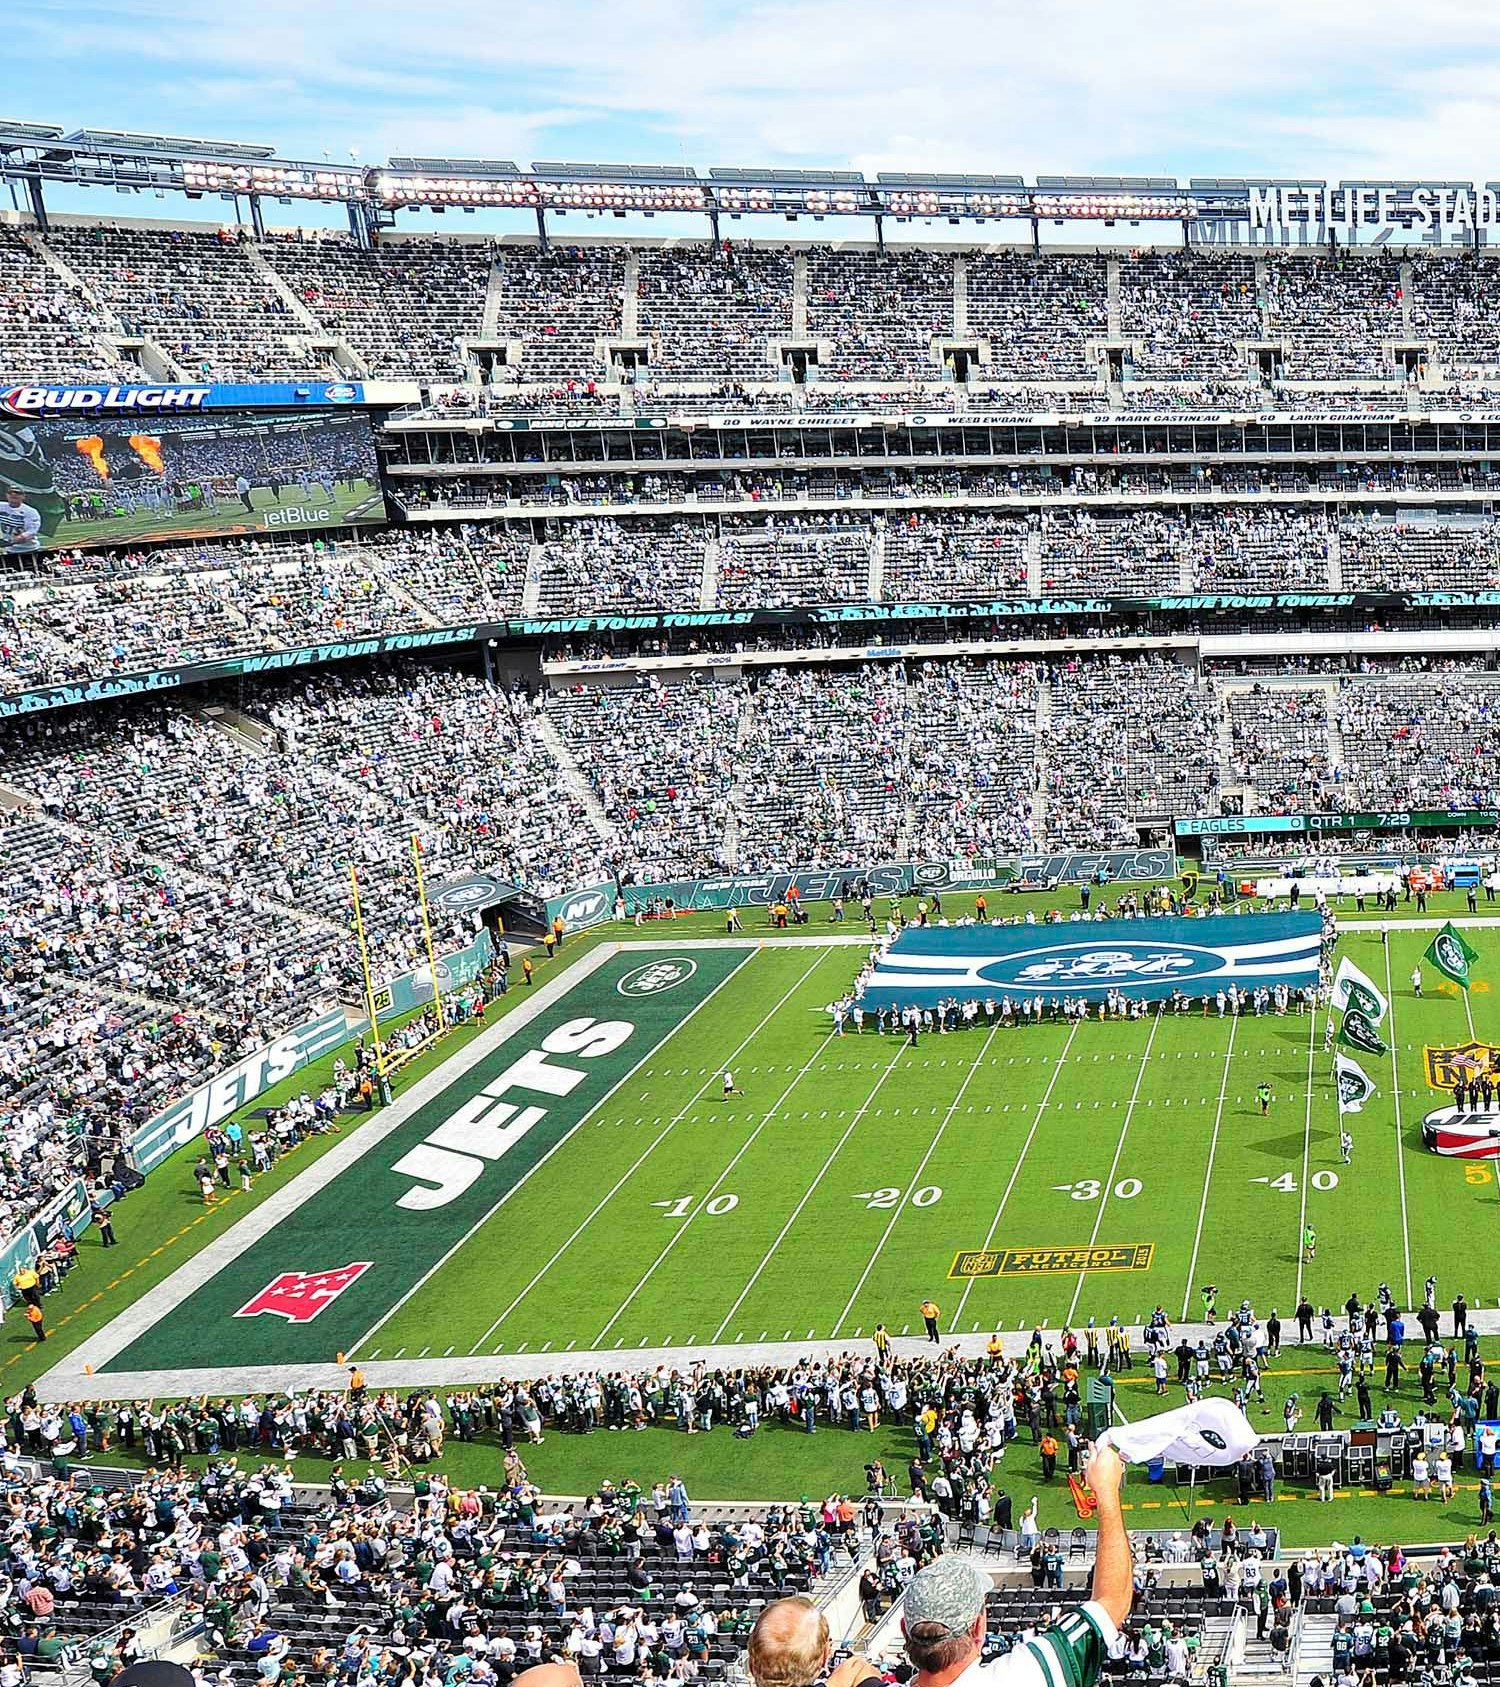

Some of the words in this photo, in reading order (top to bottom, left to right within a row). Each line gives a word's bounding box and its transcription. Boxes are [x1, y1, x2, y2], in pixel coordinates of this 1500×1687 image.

[1249, 186, 1400, 229] METLIFE
[15, 387, 102, 410] BUD
[103, 387, 211, 409] LIGHT
[750, 418, 795, 427] WAYNE
[797, 417, 858, 426] CHREBET
[983, 416, 1034, 425] EWBANK
[1115, 415, 1150, 424] MARK
[1290, 413, 1328, 422] LARRY
[1329, 413, 1396, 422] GRANTHAM
[262, 507, 331, 529] jetBlue
[1160, 595, 1216, 611] WAVE
[1215, 595, 1274, 609] YOUR
[1276, 594, 1356, 608] TOWELS!
[523, 617, 591, 635] WAVE
[595, 614, 660, 631] YOUR
[661, 611, 754, 629] TOWELS!
[243, 648, 319, 673] WAVE
[315, 640, 379, 662] YOUR
[384, 627, 477, 652] TOWELS!
[866, 648, 902, 656] MetLife
[706, 656, 732, 665] pepsi
[1190, 818, 1246, 833] EAGLES
[1290, 818, 1300, 829] 0
[1309, 816, 1343, 828] QTR
[1376, 813, 1411, 826] 7:29
[949, 860, 974, 871] FEEL
[949, 868, 997, 881] ORGULLO
[702, 882, 732, 891] NEW
[733, 879, 769, 889] YORK
[749, 865, 904, 908] JETS
[566, 896, 602, 920] NY
[375, 988, 391, 1010] 25
[174, 1034, 300, 1145] JETS
[392, 1016, 636, 1211] JETS
[1267, 1170, 1339, 1193] 40
[866, 1186, 944, 1210] 20
[1069, 1178, 1144, 1202] 30
[662, 1193, 740, 1218] 10
[1012, 1249, 1127, 1265] FUTBOL
[1018, 1261, 1112, 1270] AMERICANO
